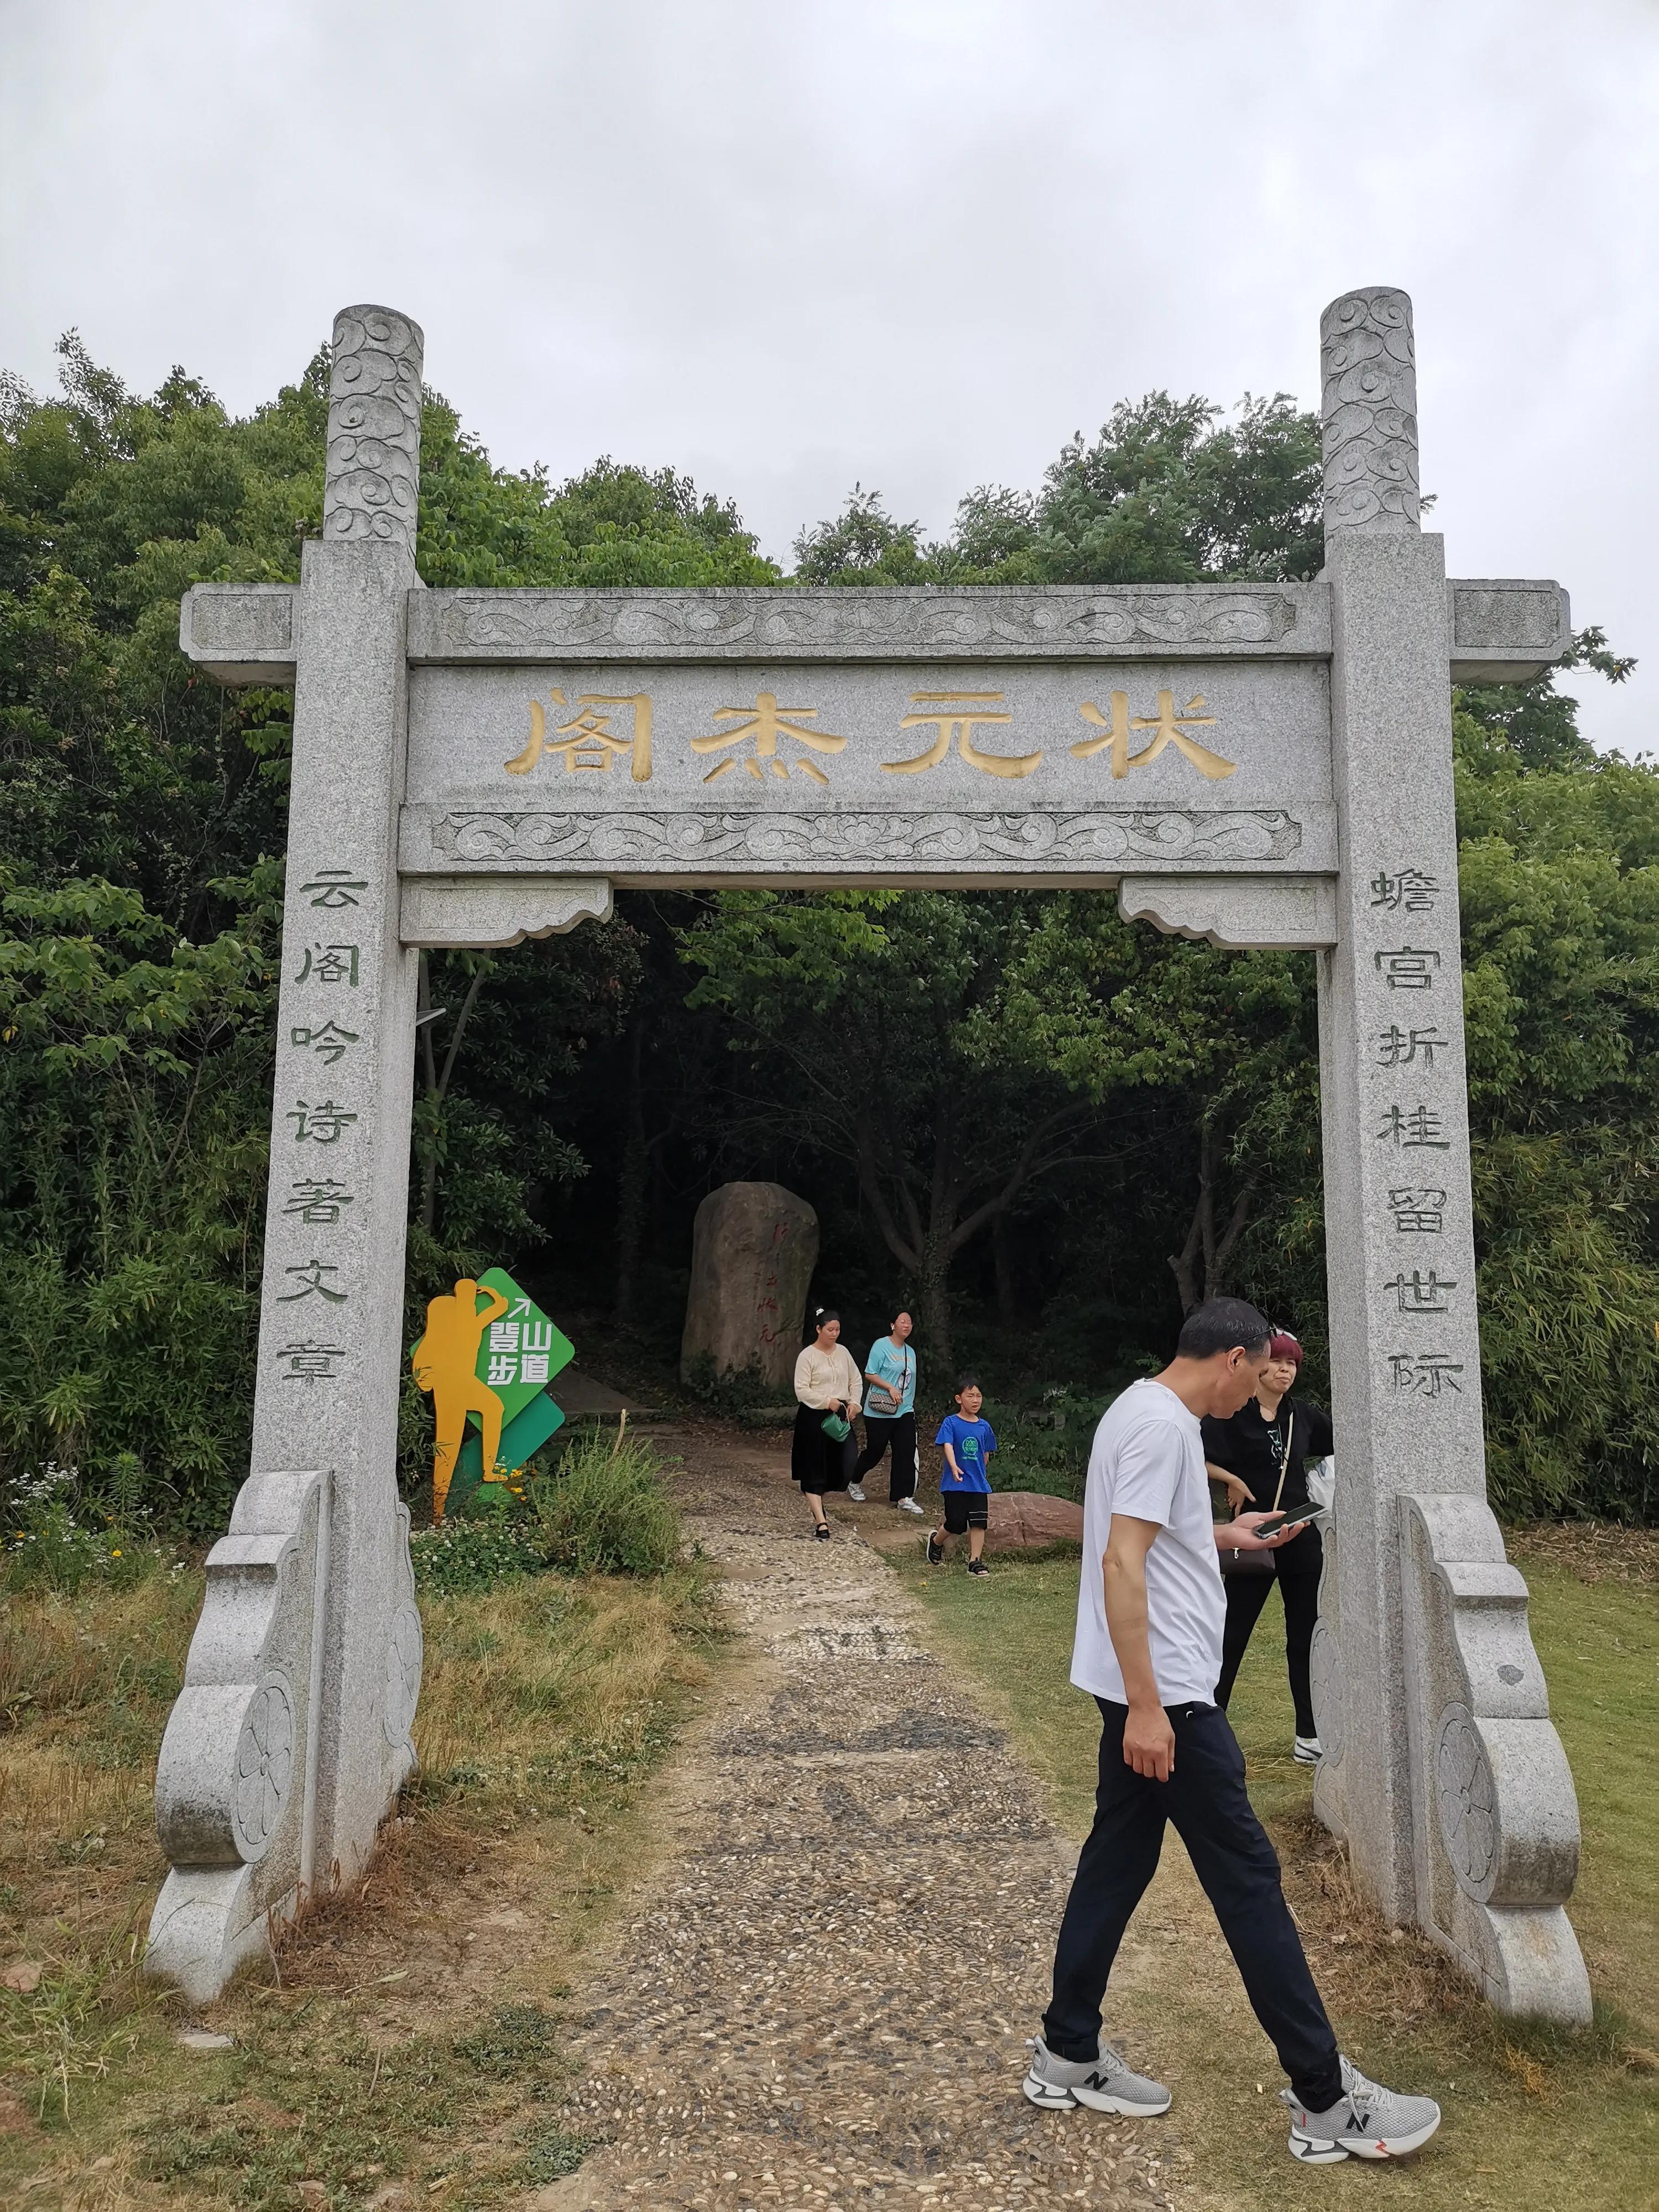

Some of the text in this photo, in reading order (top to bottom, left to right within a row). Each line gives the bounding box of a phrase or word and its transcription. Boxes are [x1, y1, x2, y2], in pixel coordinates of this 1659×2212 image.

[276, 870, 369, 1384] 云阁吟诗著文章
[1370, 868, 1464, 1399] 蟾宫折桂留世际
[489, 1321, 552, 1353] 登山
[487, 1354, 550, 1386] 步道
[1083, 2070, 1109, 2090] N
